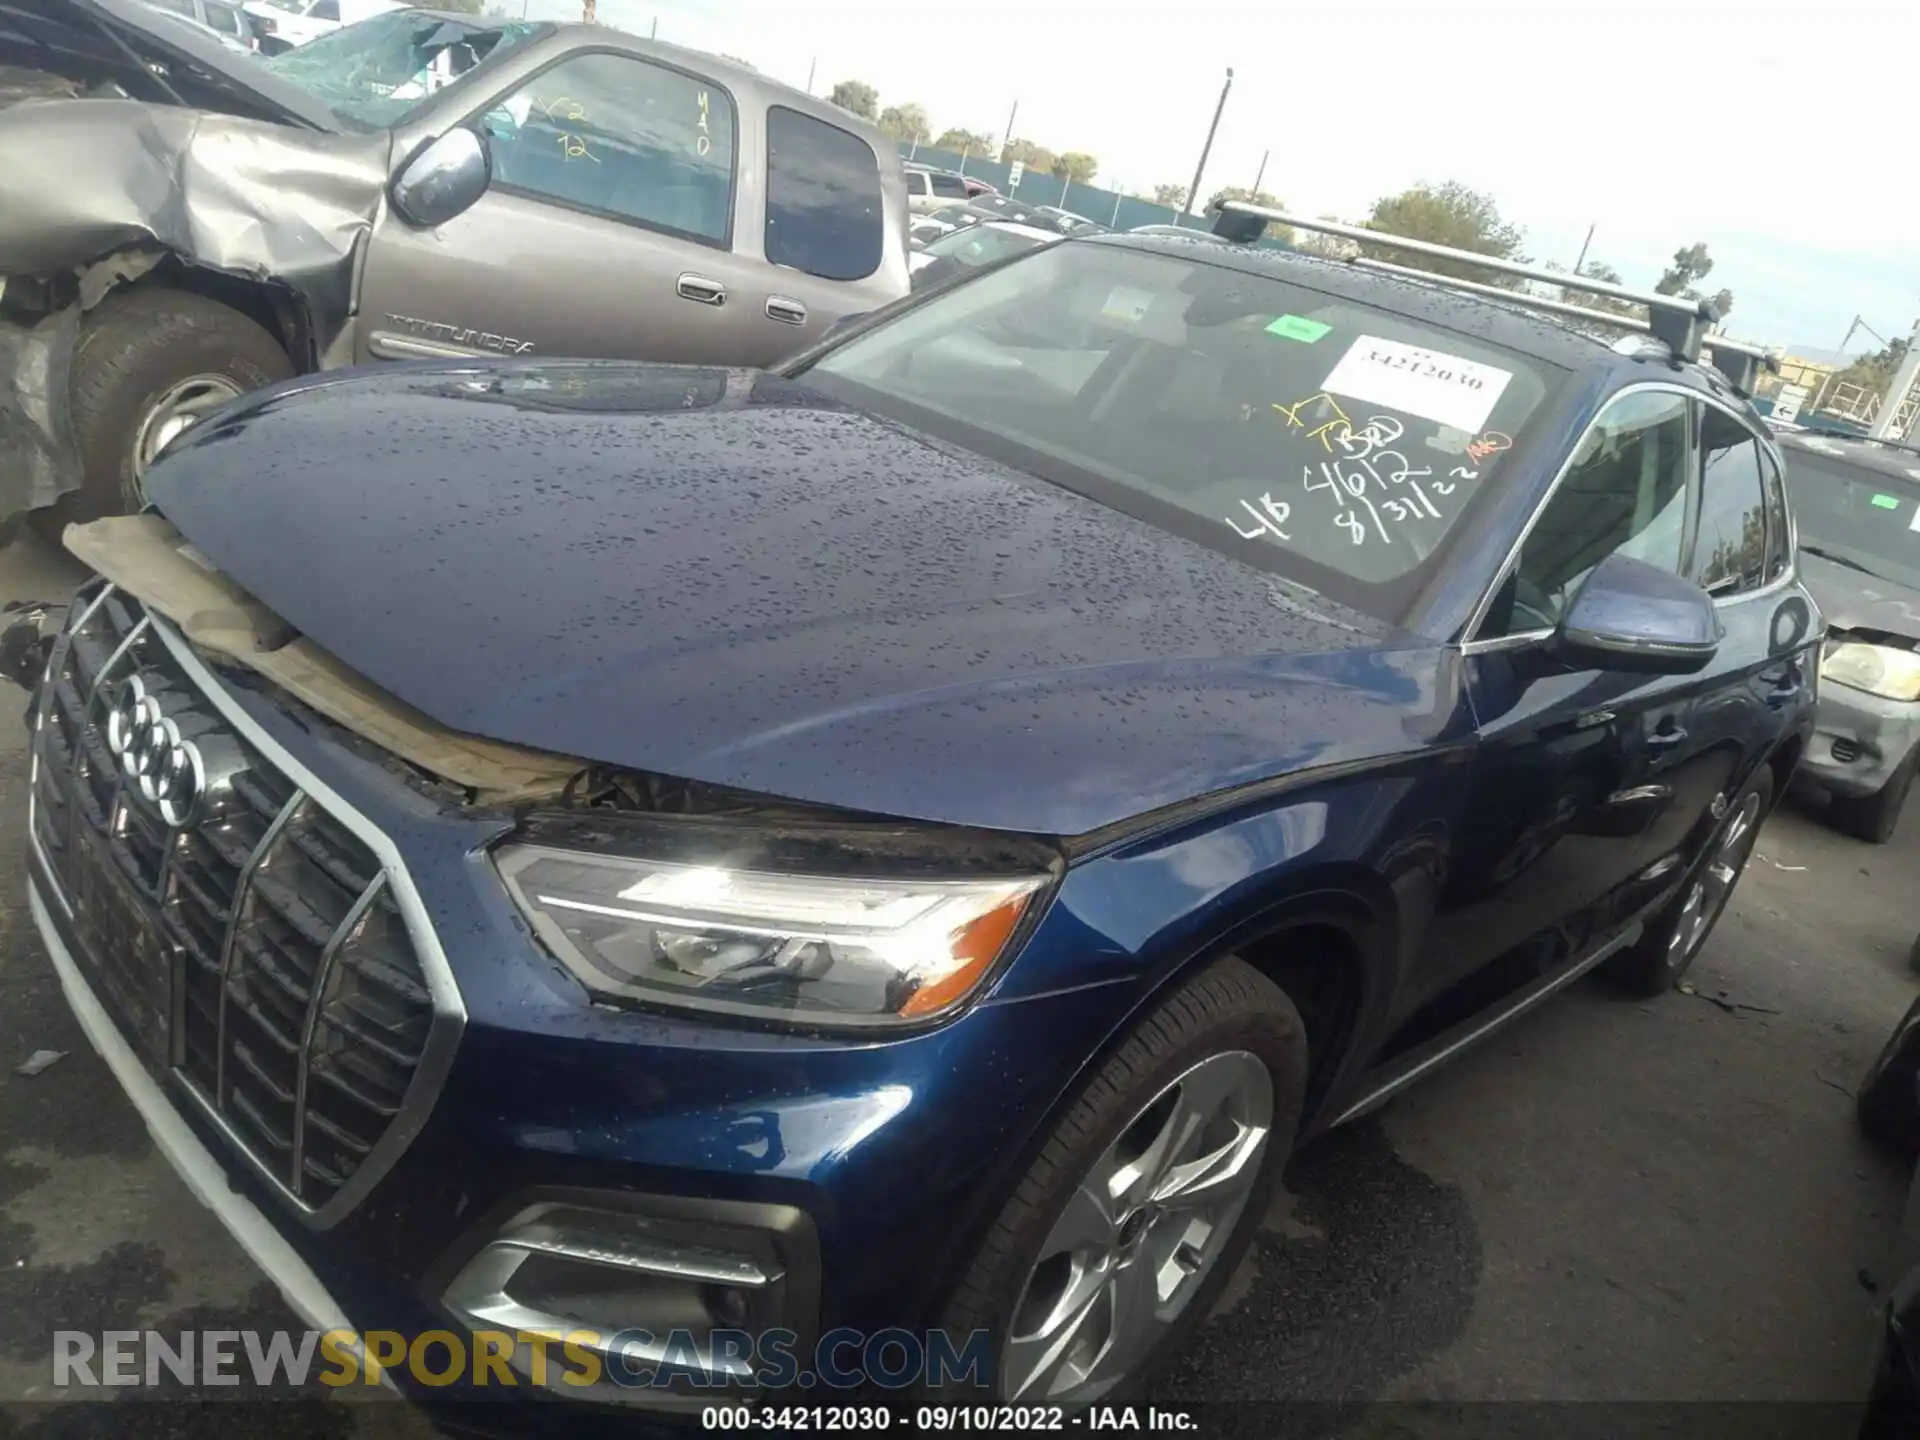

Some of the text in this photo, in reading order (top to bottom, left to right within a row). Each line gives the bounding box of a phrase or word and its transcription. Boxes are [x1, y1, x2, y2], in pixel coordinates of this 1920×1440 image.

[433, 321, 535, 354] TUNDRA
[1360, 349, 1484, 392] 34212030
[1303, 450, 1433, 507] 4612
